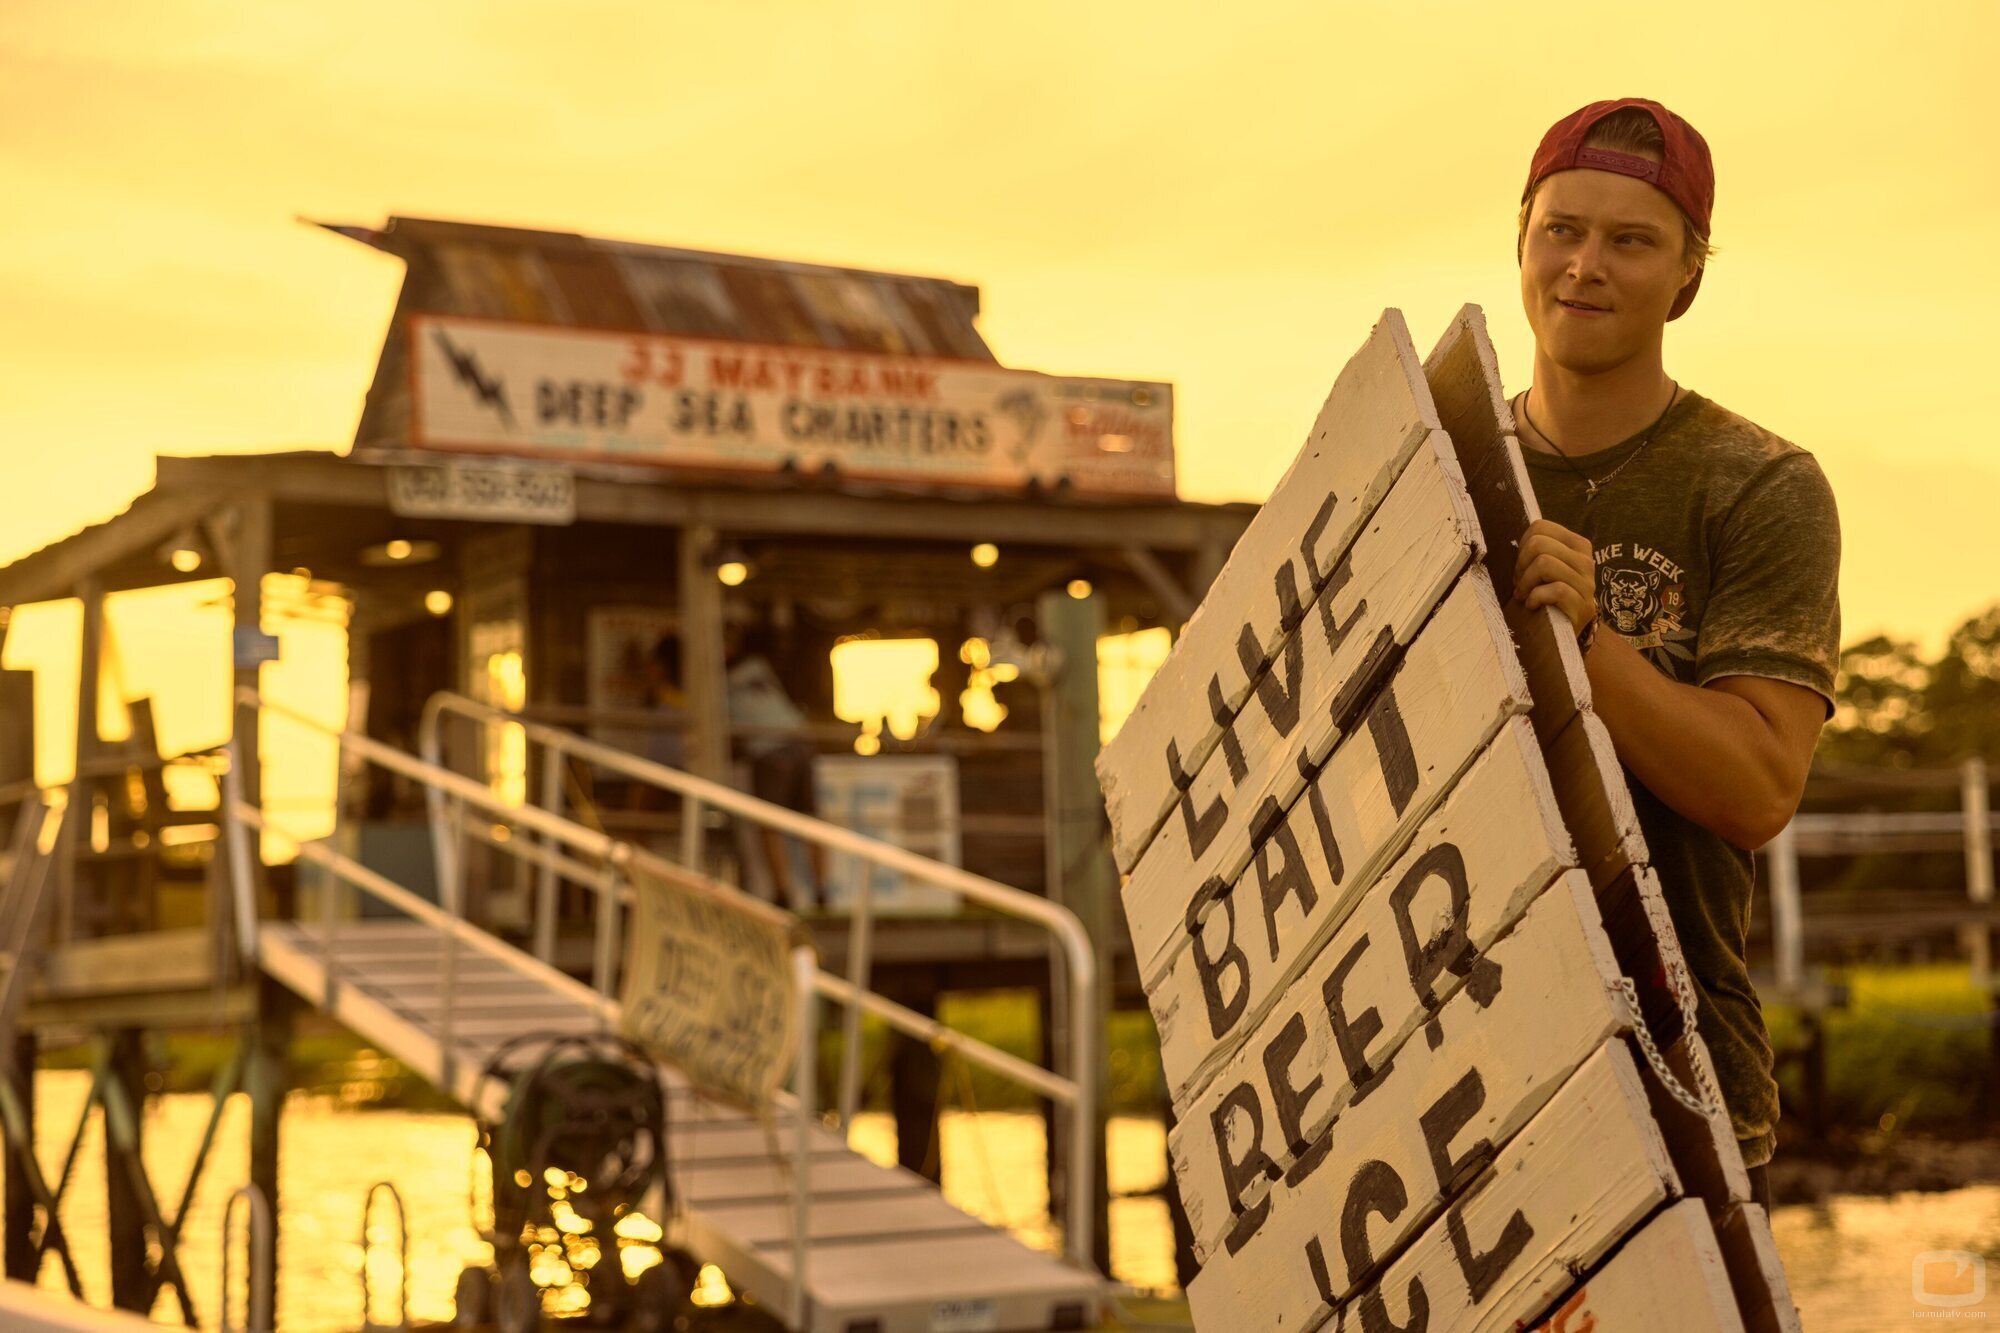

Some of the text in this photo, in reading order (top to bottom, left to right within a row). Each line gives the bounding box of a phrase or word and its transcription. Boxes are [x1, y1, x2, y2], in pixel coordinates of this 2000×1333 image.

[536, 379, 643, 431] DEEP
[671, 391, 756, 441] SEA
[781, 399, 995, 457] CHARTERS
[709, 349, 940, 401] MAYBANK
[1166, 490, 1368, 862] LIVE
[1594, 543, 1686, 583] IKE WEEK
[1185, 624, 1419, 1040] BAIT
[1211, 842, 1502, 1258] BEER
[1305, 1066, 1534, 1333] ICE
